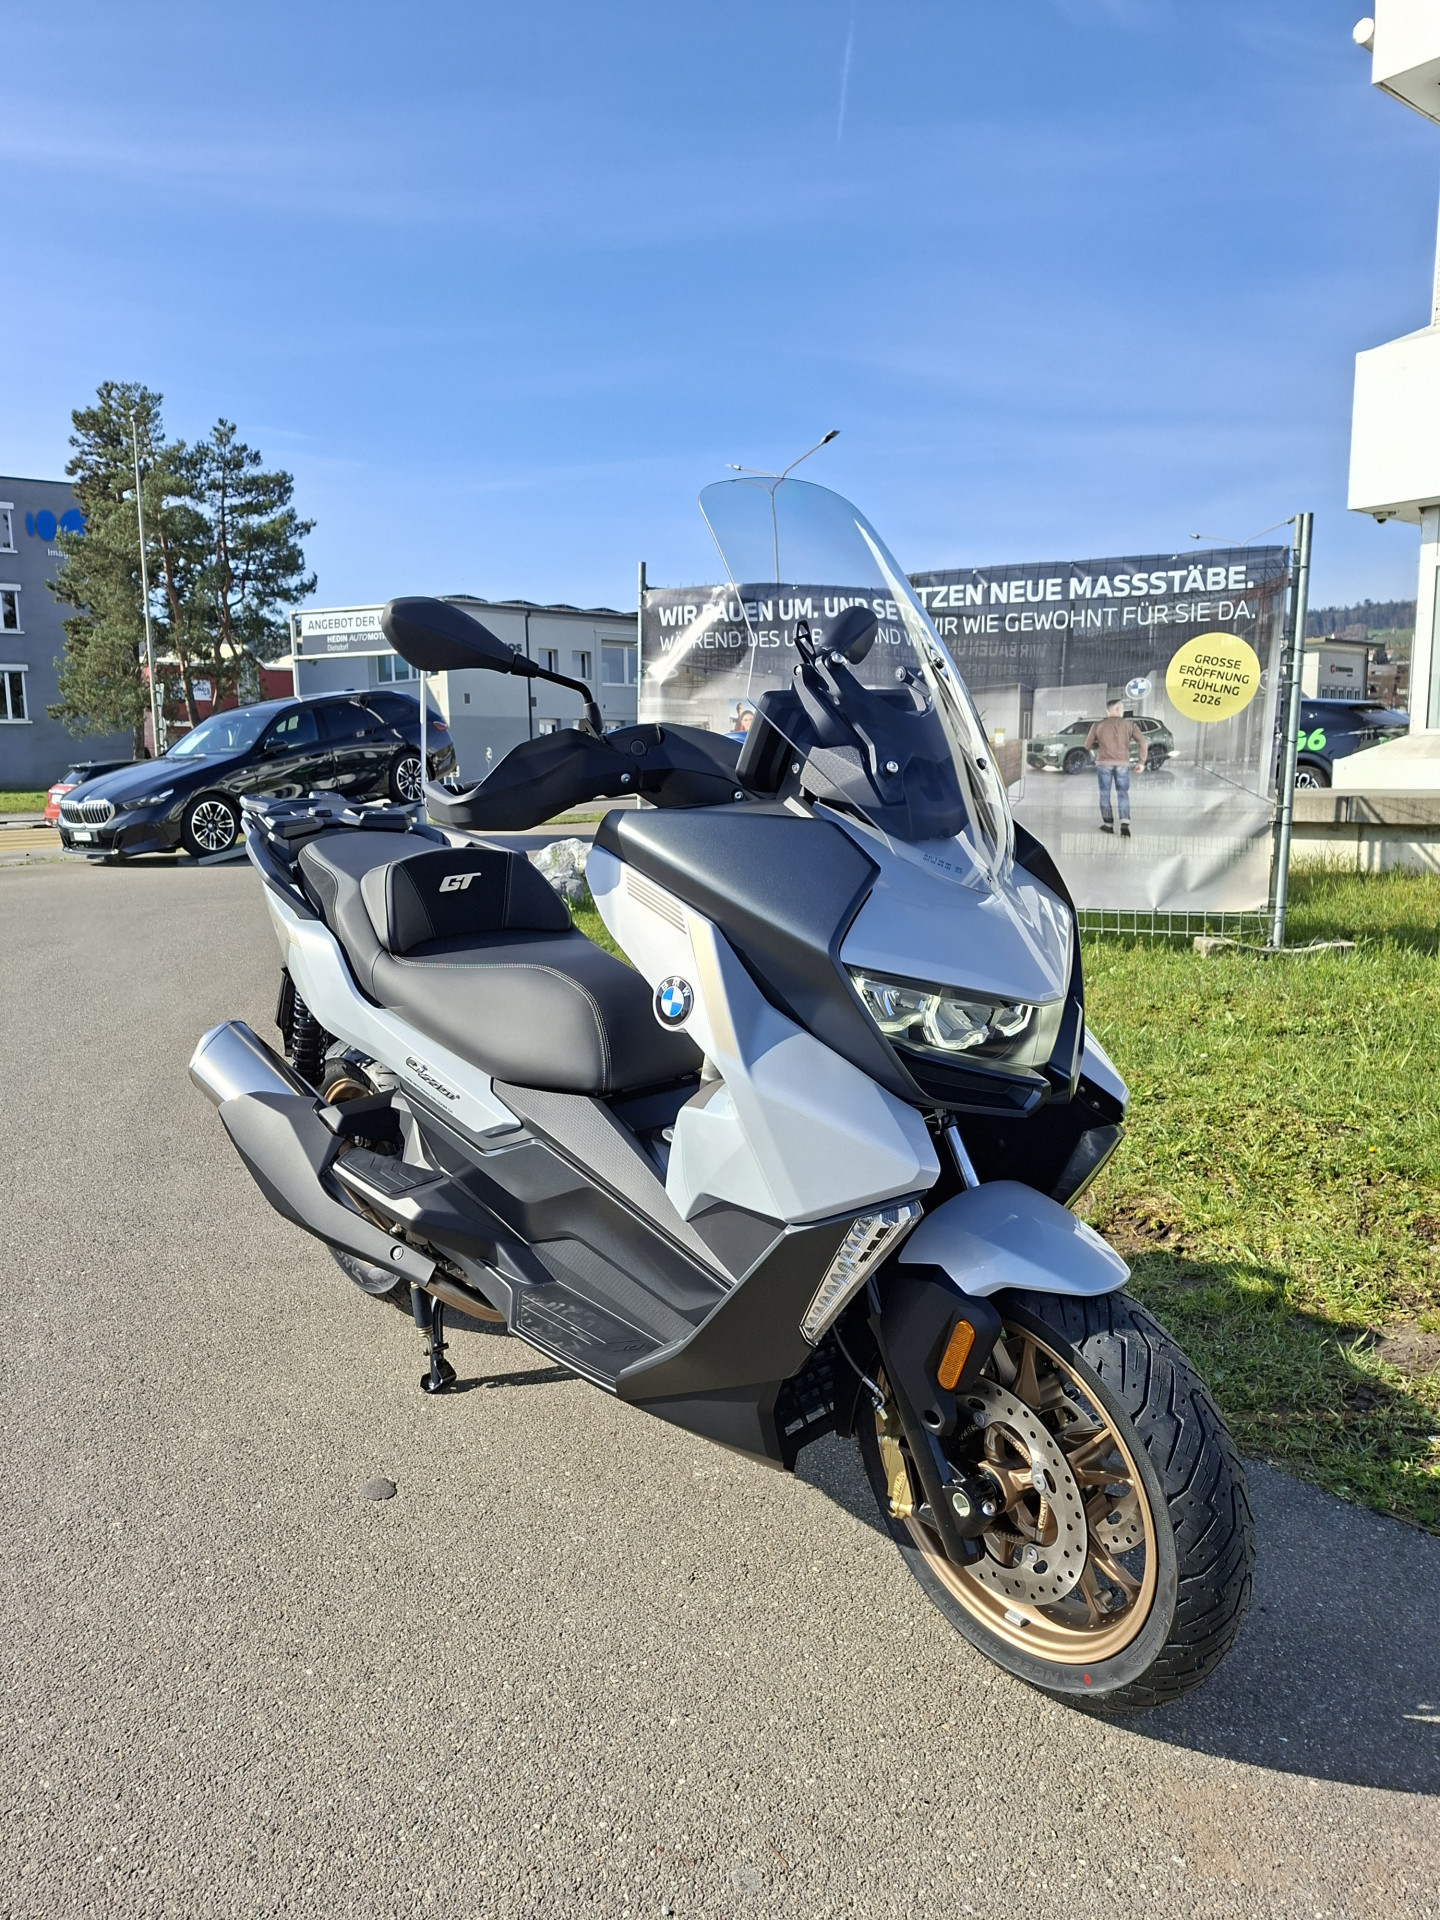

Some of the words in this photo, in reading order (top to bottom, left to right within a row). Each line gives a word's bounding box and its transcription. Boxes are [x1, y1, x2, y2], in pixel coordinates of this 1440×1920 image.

[47, 548, 69, 559] Imag
[658, 605, 698, 627] WIR
[778, 597, 819, 621] UM.
[989, 577, 1063, 605] NEUE
[1068, 564, 1255, 600] MASSSTÄBE.
[307, 617, 354, 631] ANGEBOT
[355, 615, 376, 627] DER
[659, 631, 742, 652] WREND
[747, 630, 781, 649] DES
[962, 613, 999, 634] WIE
[1004, 608, 1118, 633] GEWOHNT
[1122, 602, 1169, 626] FÜR
[1174, 602, 1211, 624] SIE
[1217, 599, 1256, 621] DA.
[326, 634, 348, 644] HEDIN
[327, 642, 349, 652] Dielsdorf
[508, 642, 523, 654] OS
[1194, 653, 1242, 670] GROSSE
[1179, 665, 1250, 685] ERÖFFNUNG
[1181, 678, 1240, 696] FRÜHLING
[1192, 692, 1222, 706] 2026
[438, 871, 482, 893] GT
